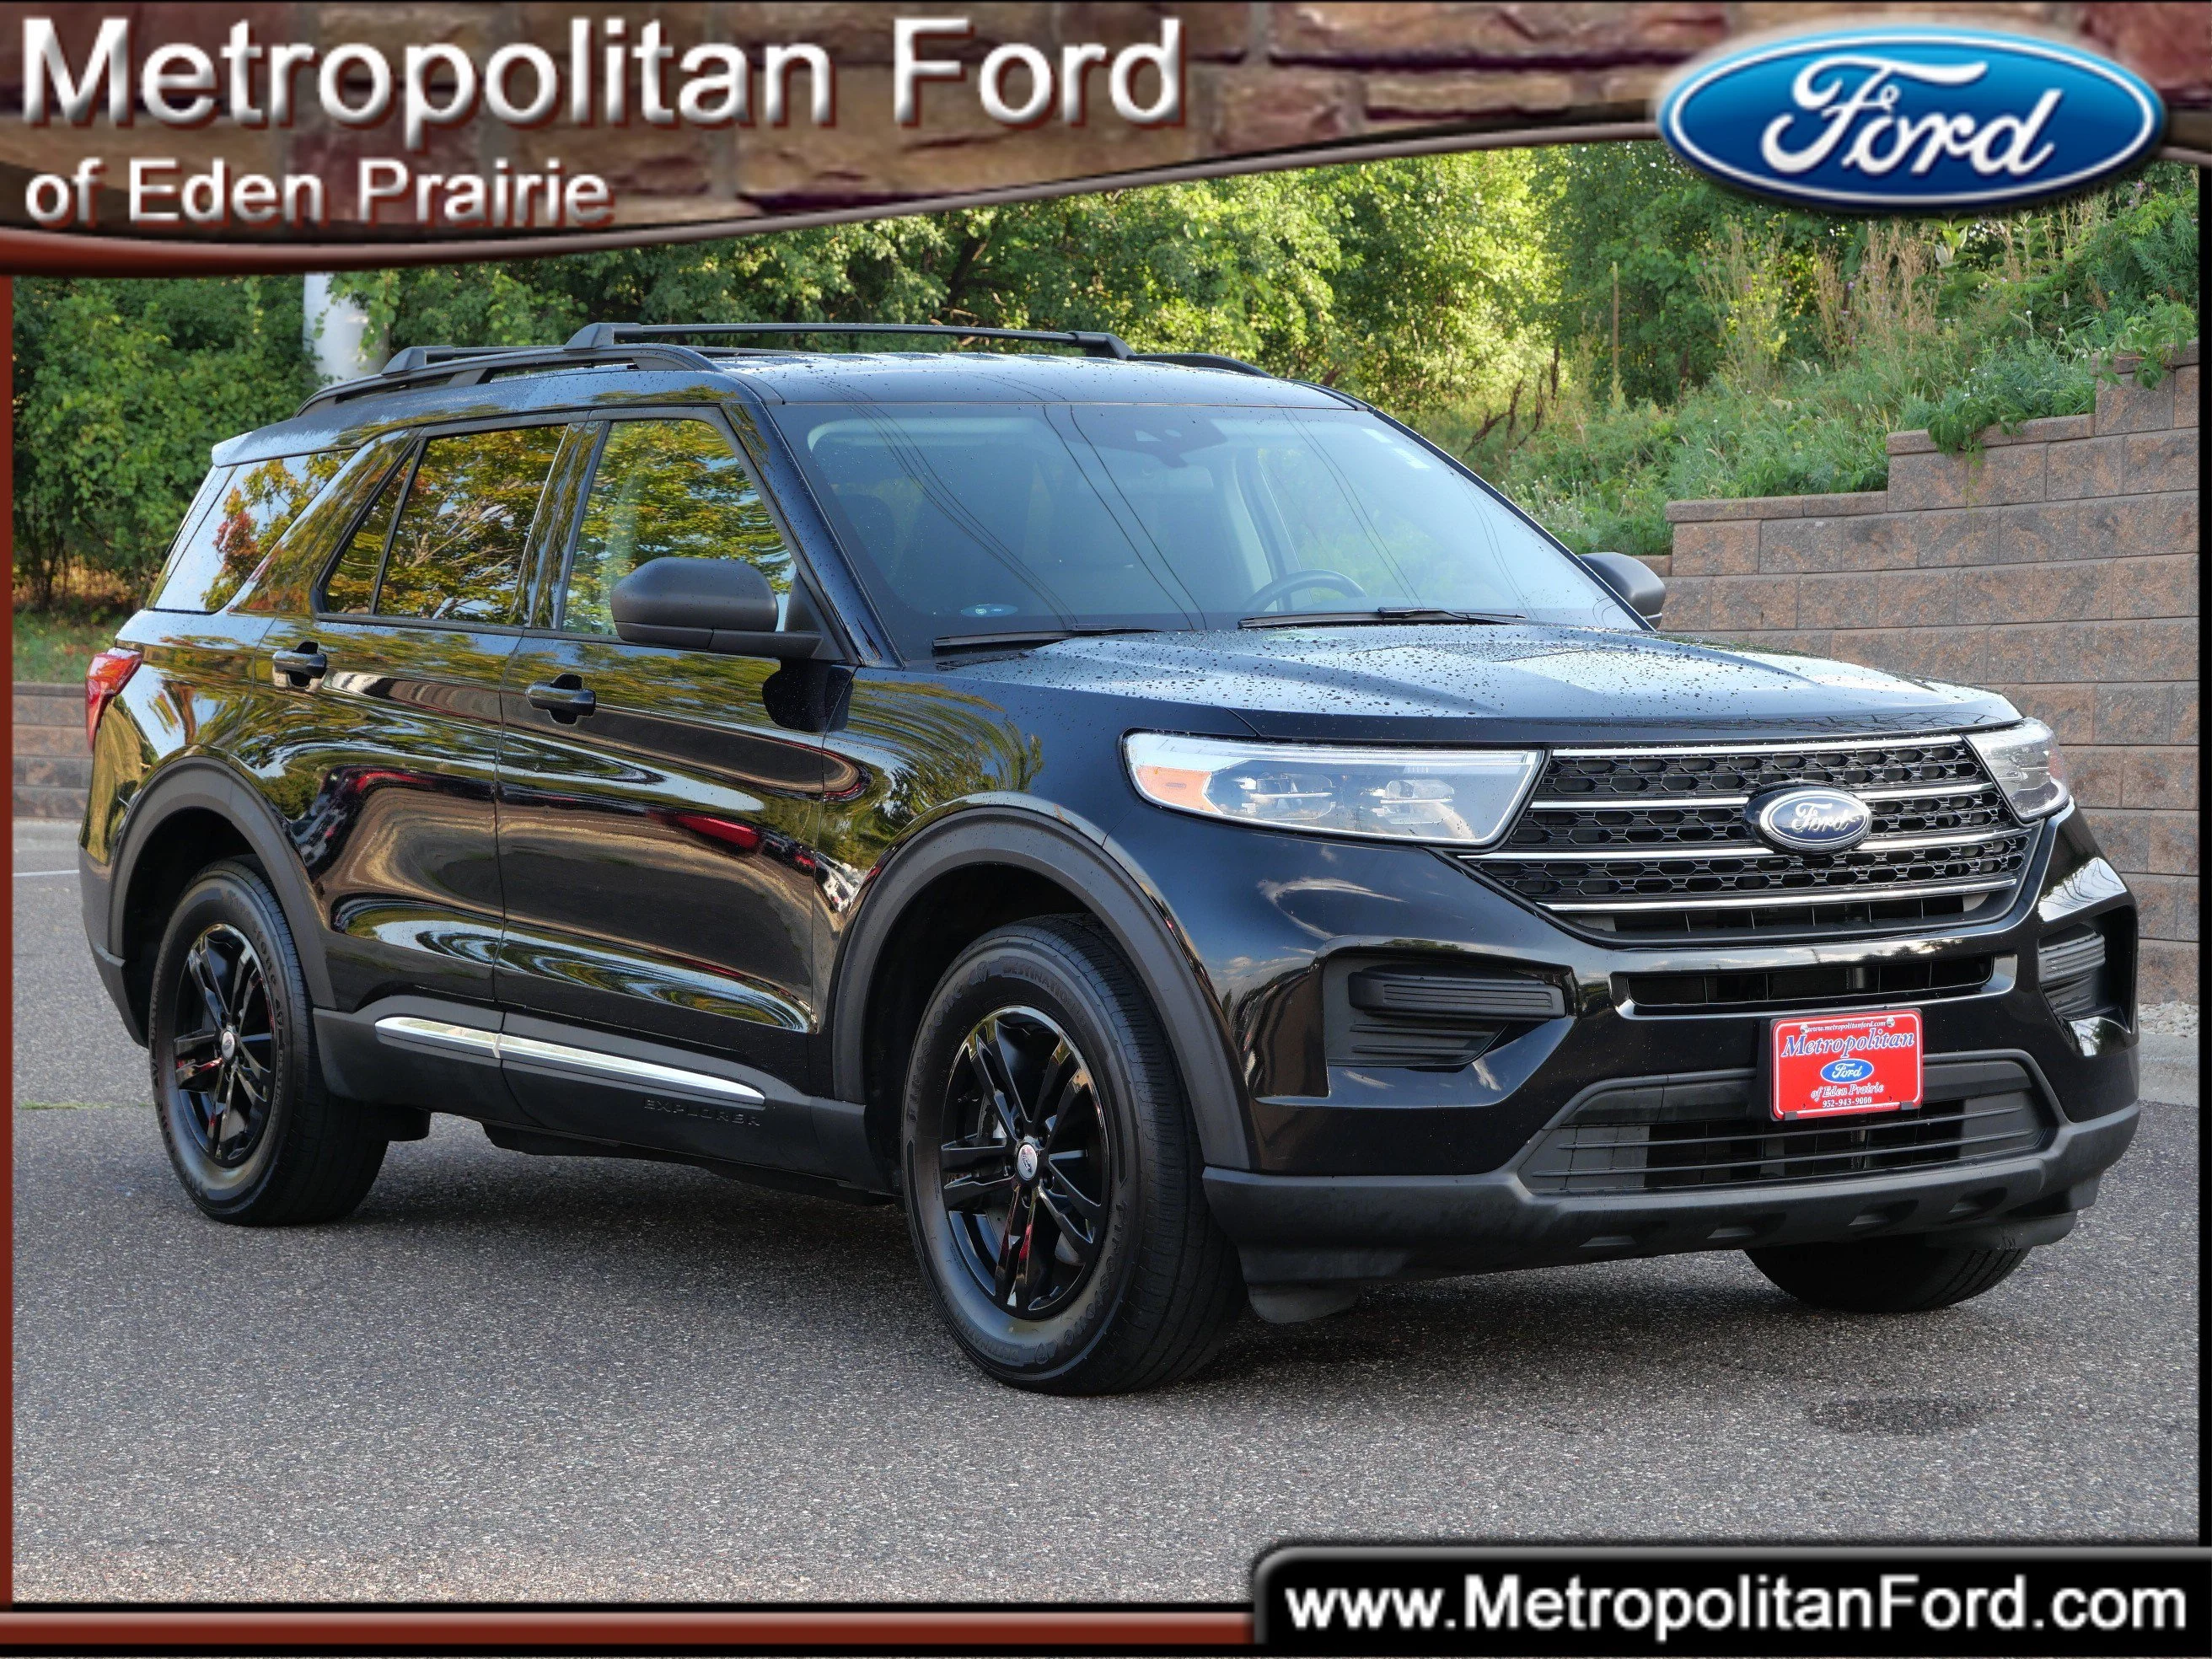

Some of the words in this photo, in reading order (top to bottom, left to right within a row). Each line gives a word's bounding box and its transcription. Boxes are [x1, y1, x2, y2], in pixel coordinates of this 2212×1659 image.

[1791, 802, 1860, 833] Ford
[1807, 1020, 1886, 1033] www.metropolitanford.com
[1780, 1028, 1914, 1059] Metropolitan
[1832, 1063, 1862, 1079] Ford
[1811, 1087, 1823, 1102] of
[1823, 1084, 1847, 1097] Eden
[1849, 1081, 1884, 1096] Prairie
[644, 1099, 760, 1126] EXPLORER
[1823, 1097, 1872, 1108] 952-943-9000
